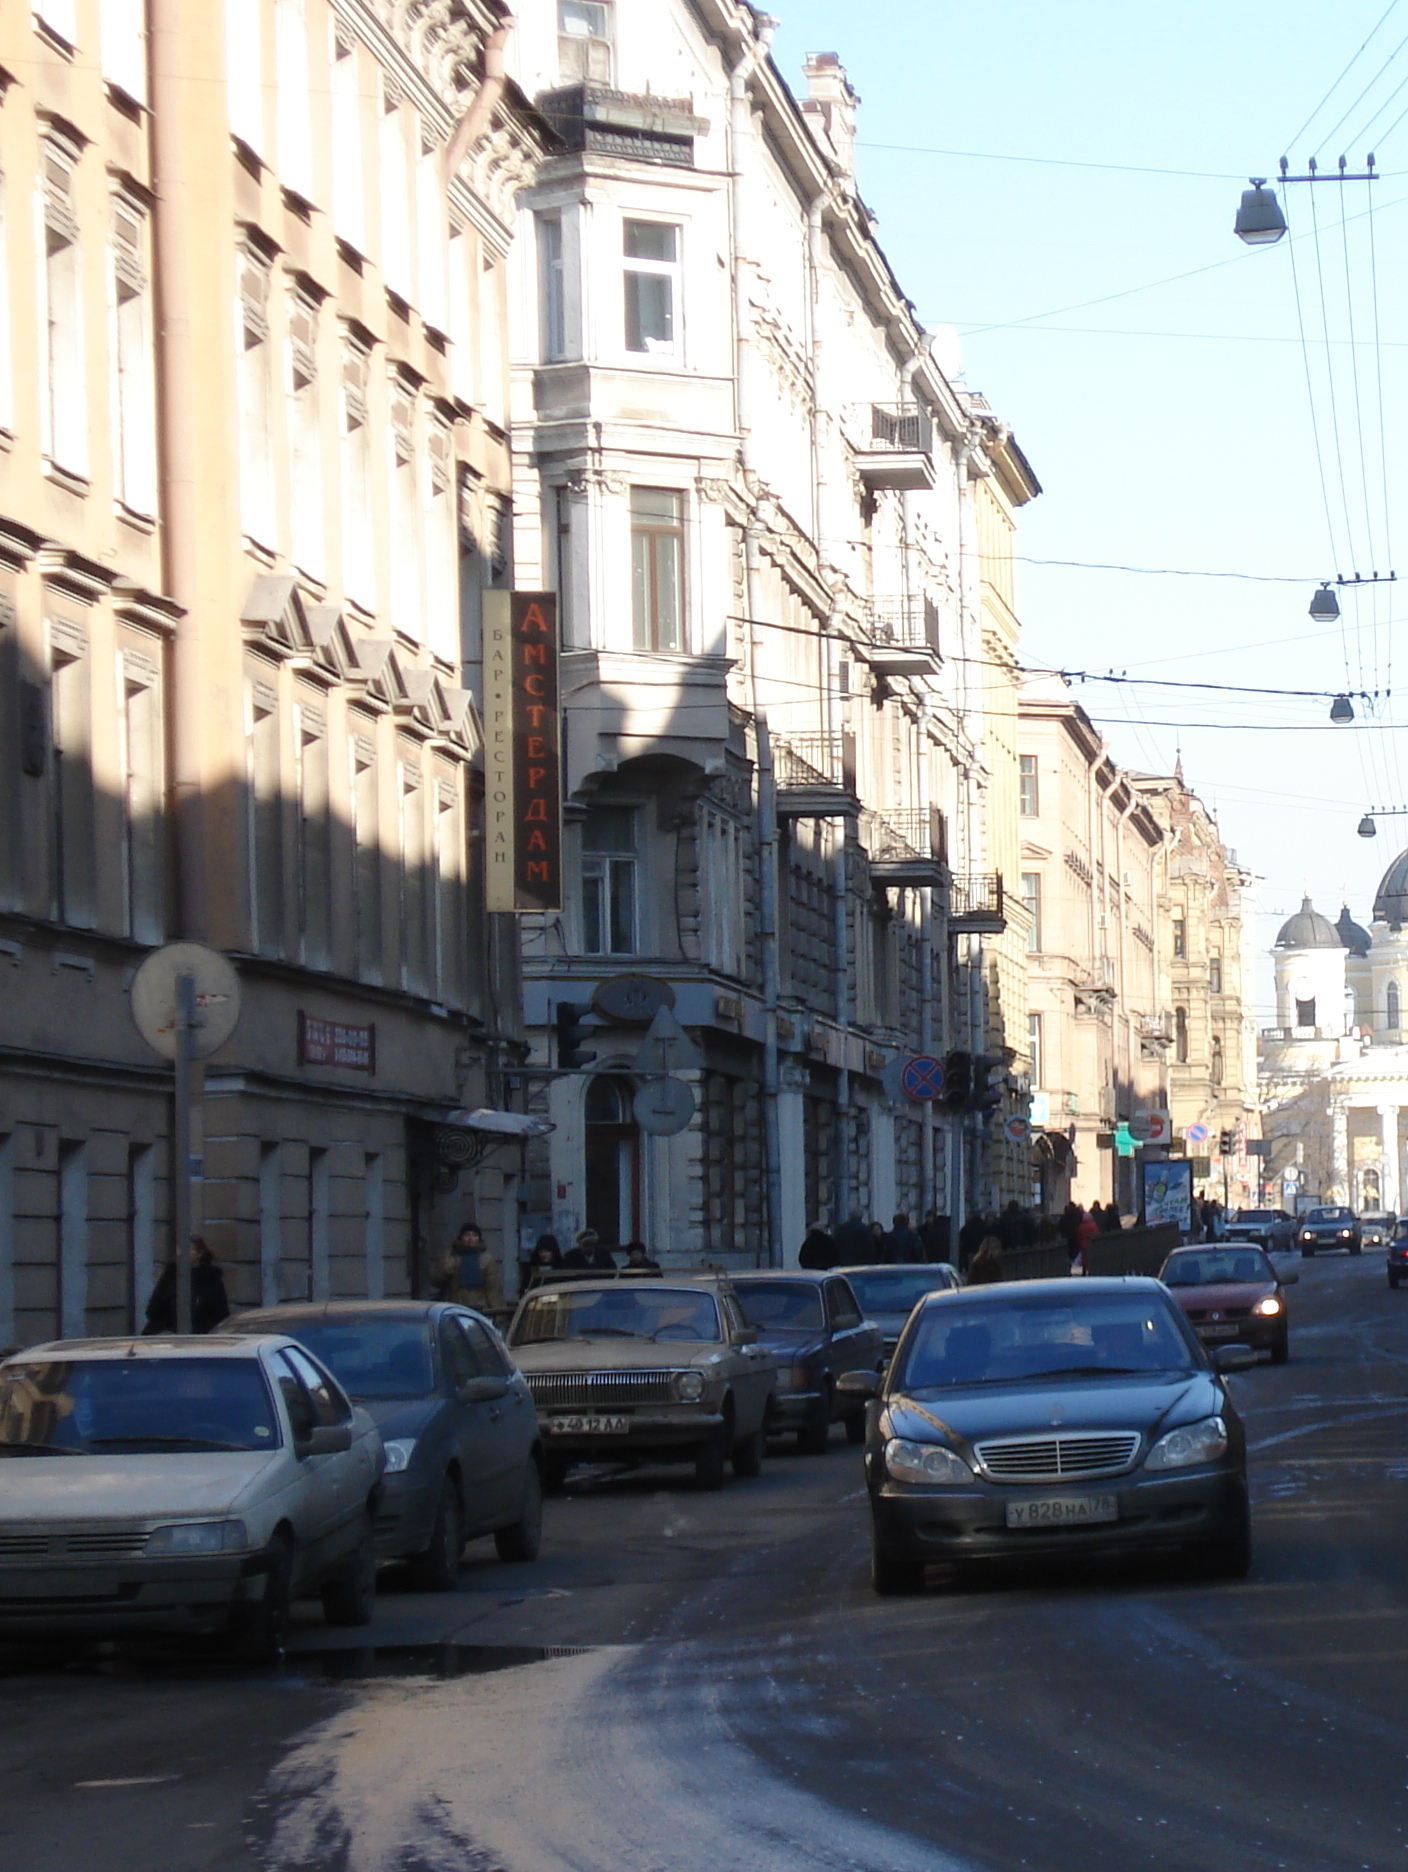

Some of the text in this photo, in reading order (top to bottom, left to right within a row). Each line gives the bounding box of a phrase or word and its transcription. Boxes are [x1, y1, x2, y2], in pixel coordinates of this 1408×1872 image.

[492, 629, 506, 864] БАР РЕСТОРАН
[520, 602, 549, 883] АМСТЕРДАМ
